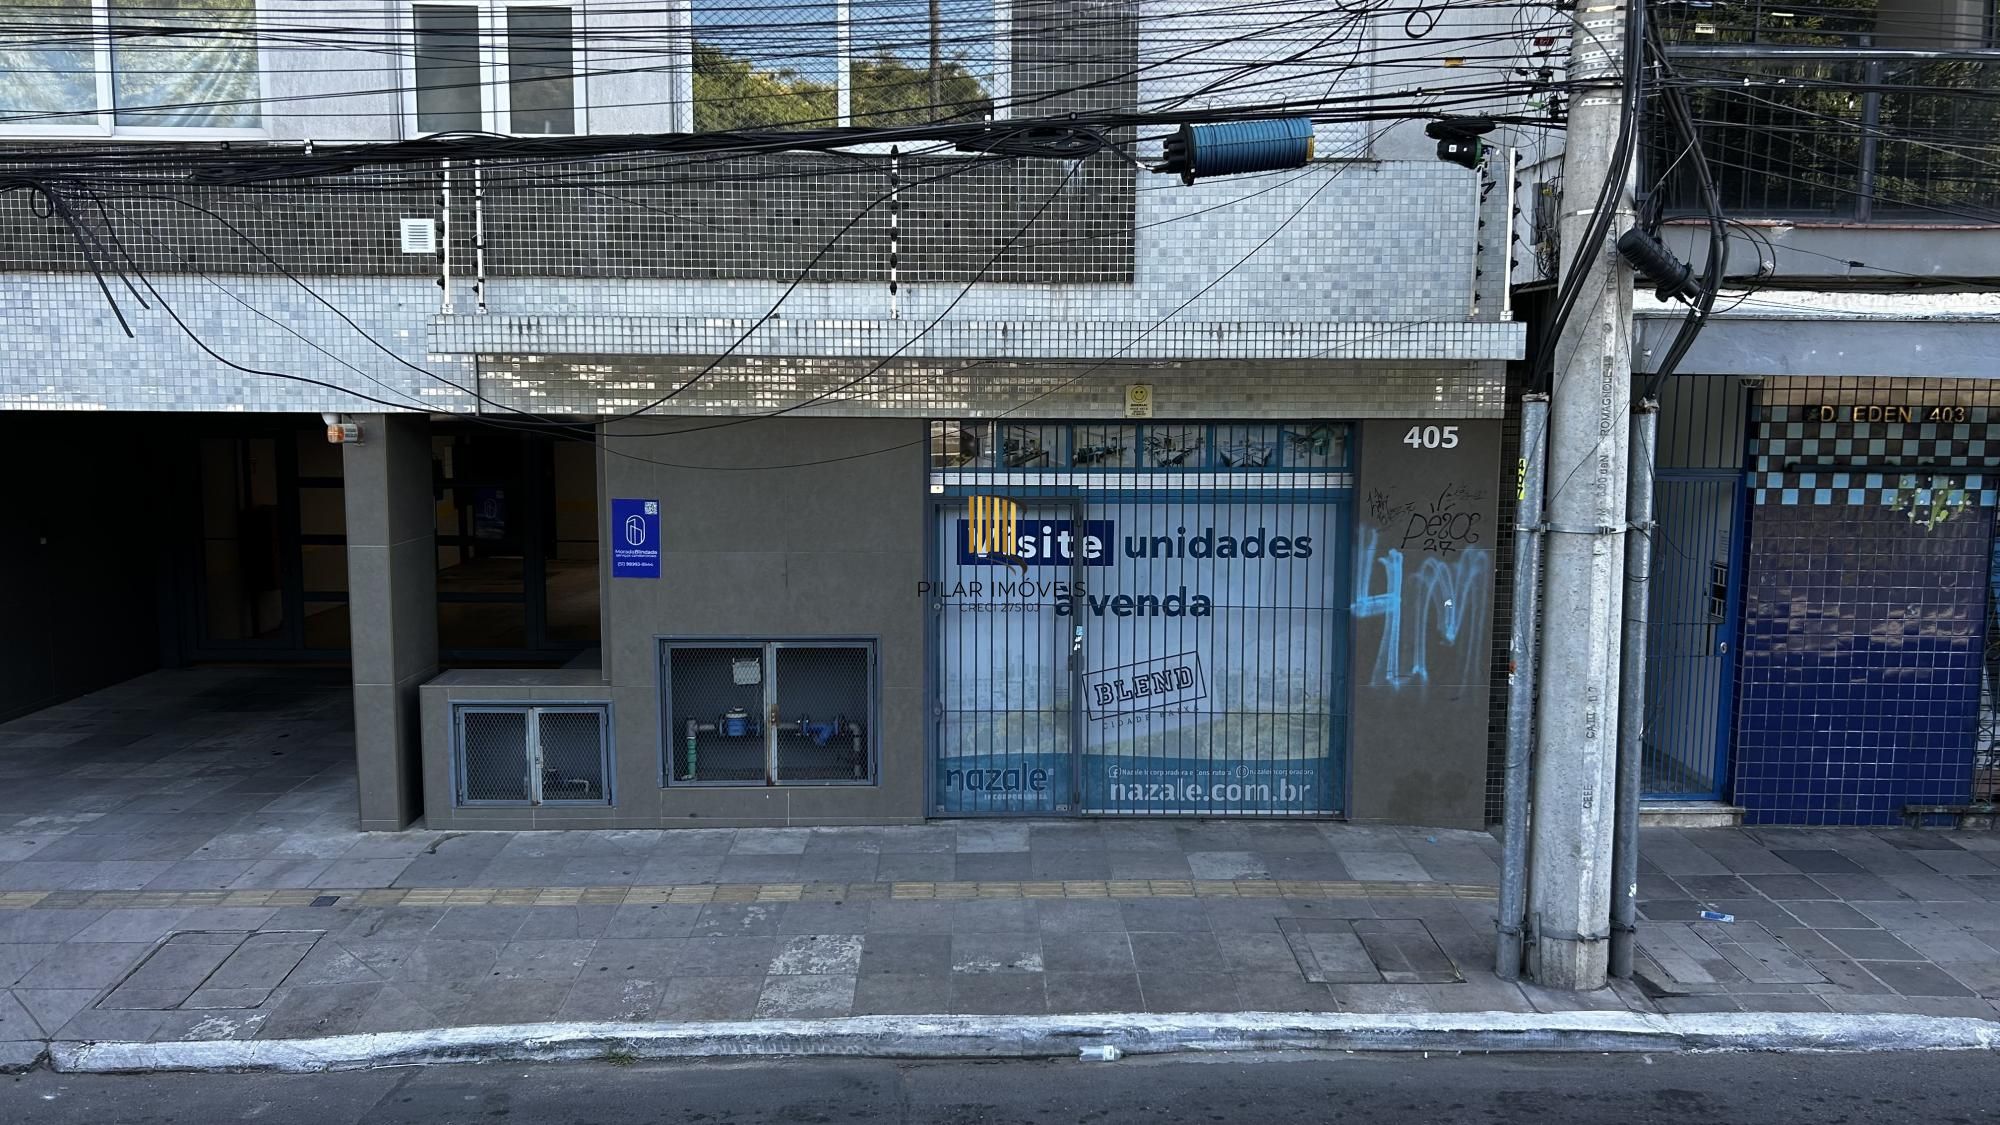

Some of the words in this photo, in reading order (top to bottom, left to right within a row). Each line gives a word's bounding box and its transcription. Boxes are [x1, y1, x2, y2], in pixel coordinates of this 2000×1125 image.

[1853, 405, 1912, 423] EDEN
[1929, 406, 1965, 422] 403
[1403, 426, 1458, 449] 405
[1124, 527, 1313, 559] unidades
[1088, 586, 1211, 617] venda
[1094, 665, 1194, 707] BLEND
[1159, 705, 1200, 719] BAXA
[946, 761, 1048, 792] nazale
[1110, 778, 1311, 802] nazale.com.br
[1582, 784, 1594, 809] CEEE
